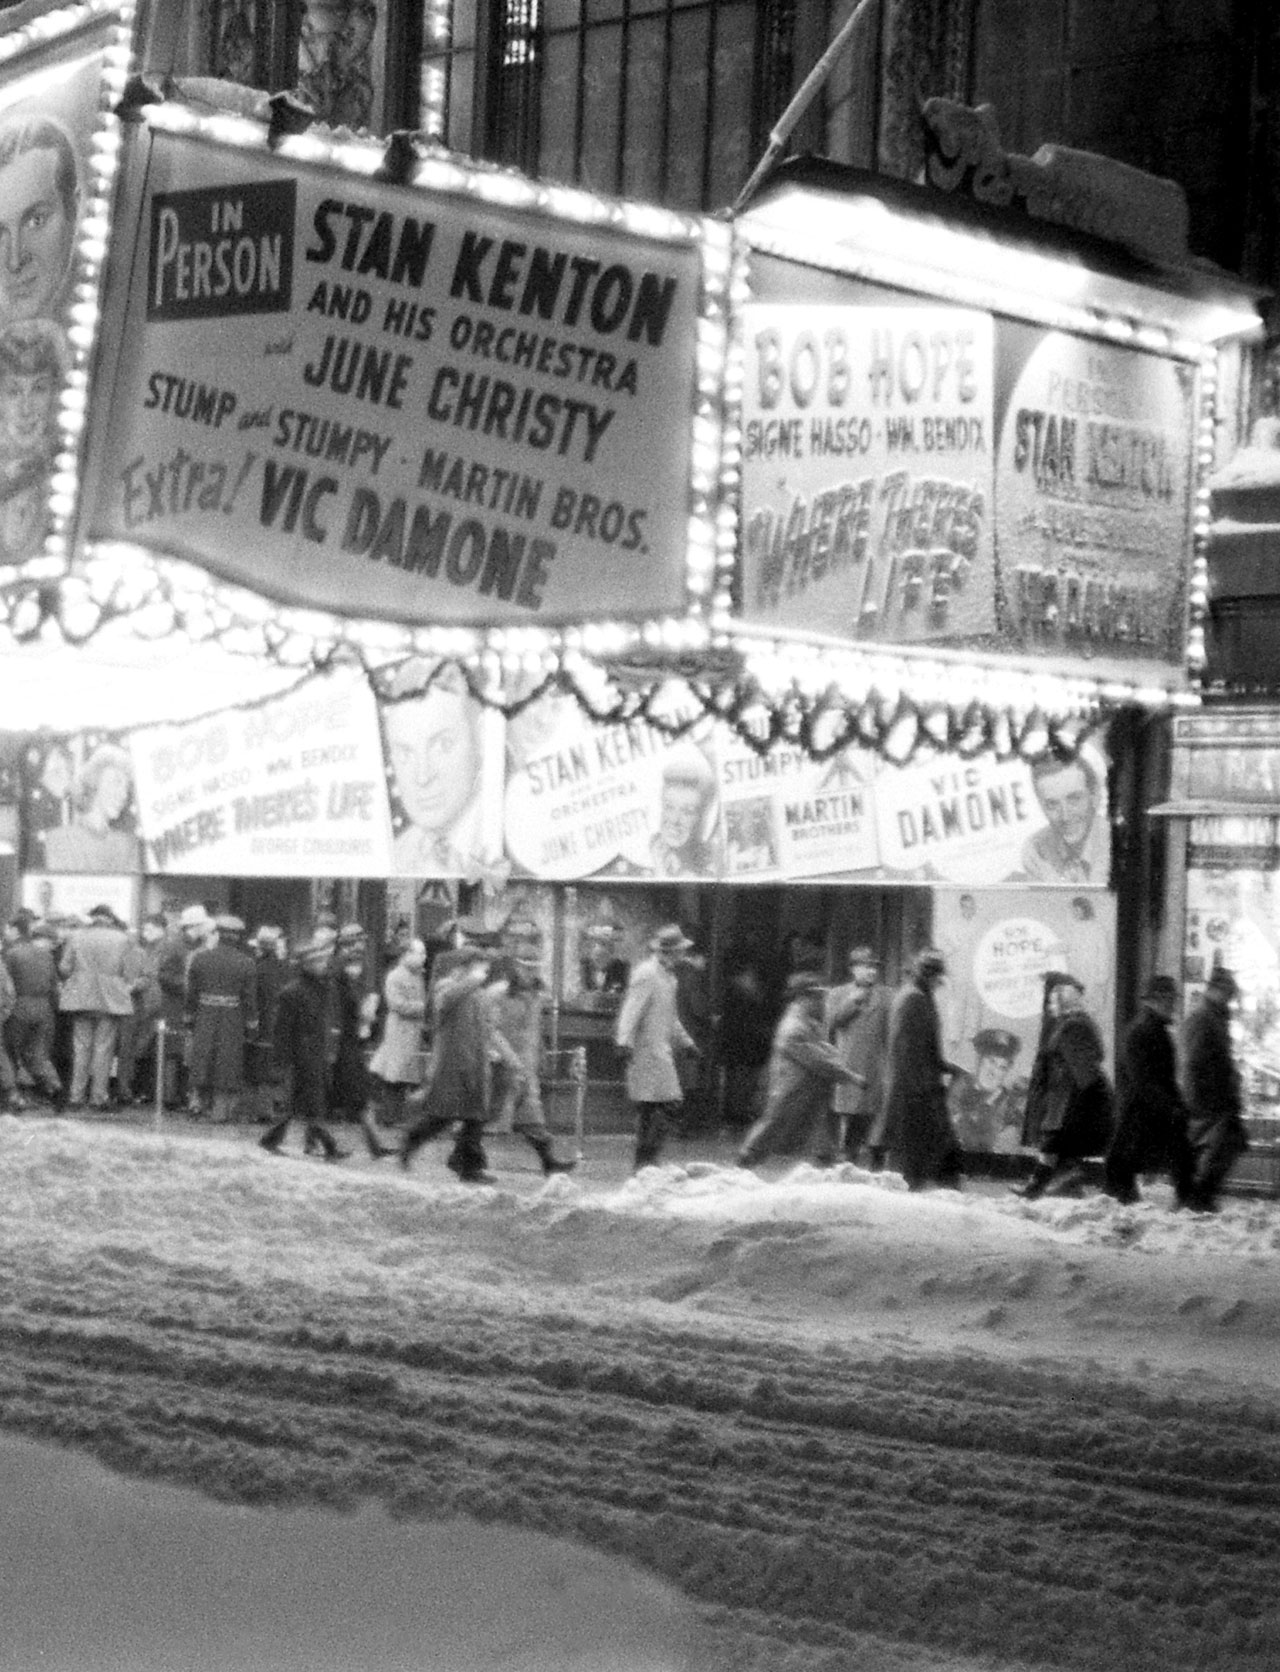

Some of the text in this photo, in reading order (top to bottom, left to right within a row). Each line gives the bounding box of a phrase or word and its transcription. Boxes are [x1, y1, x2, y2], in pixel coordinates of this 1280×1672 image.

[156, 208, 283, 307] PERSON
[211, 202, 243, 233] IN
[306, 199, 678, 346] STAN KENTON
[306, 281, 639, 396] AND HIS ORCHESTRA
[754, 326, 978, 410] BOB HOPE
[304, 334, 413, 410] JUNE
[426, 366, 617, 463] CHRISTY
[745, 418, 804, 461] SIGNE
[810, 416, 872, 457] HASSO
[922, 416, 986, 454] BENDIX
[144, 372, 651, 554] STUMP and STUMPY MARTIN BROS.
[120, 448, 558, 611] Extra! VIC DAMONE
[526, 743, 589, 796] STAN
[784, 793, 864, 826] MARTIN
[931, 768, 981, 796] VIC
[148, 802, 227, 868] WHERE
[326, 781, 377, 821] LIFE
[897, 782, 1027, 849] DAMONE
